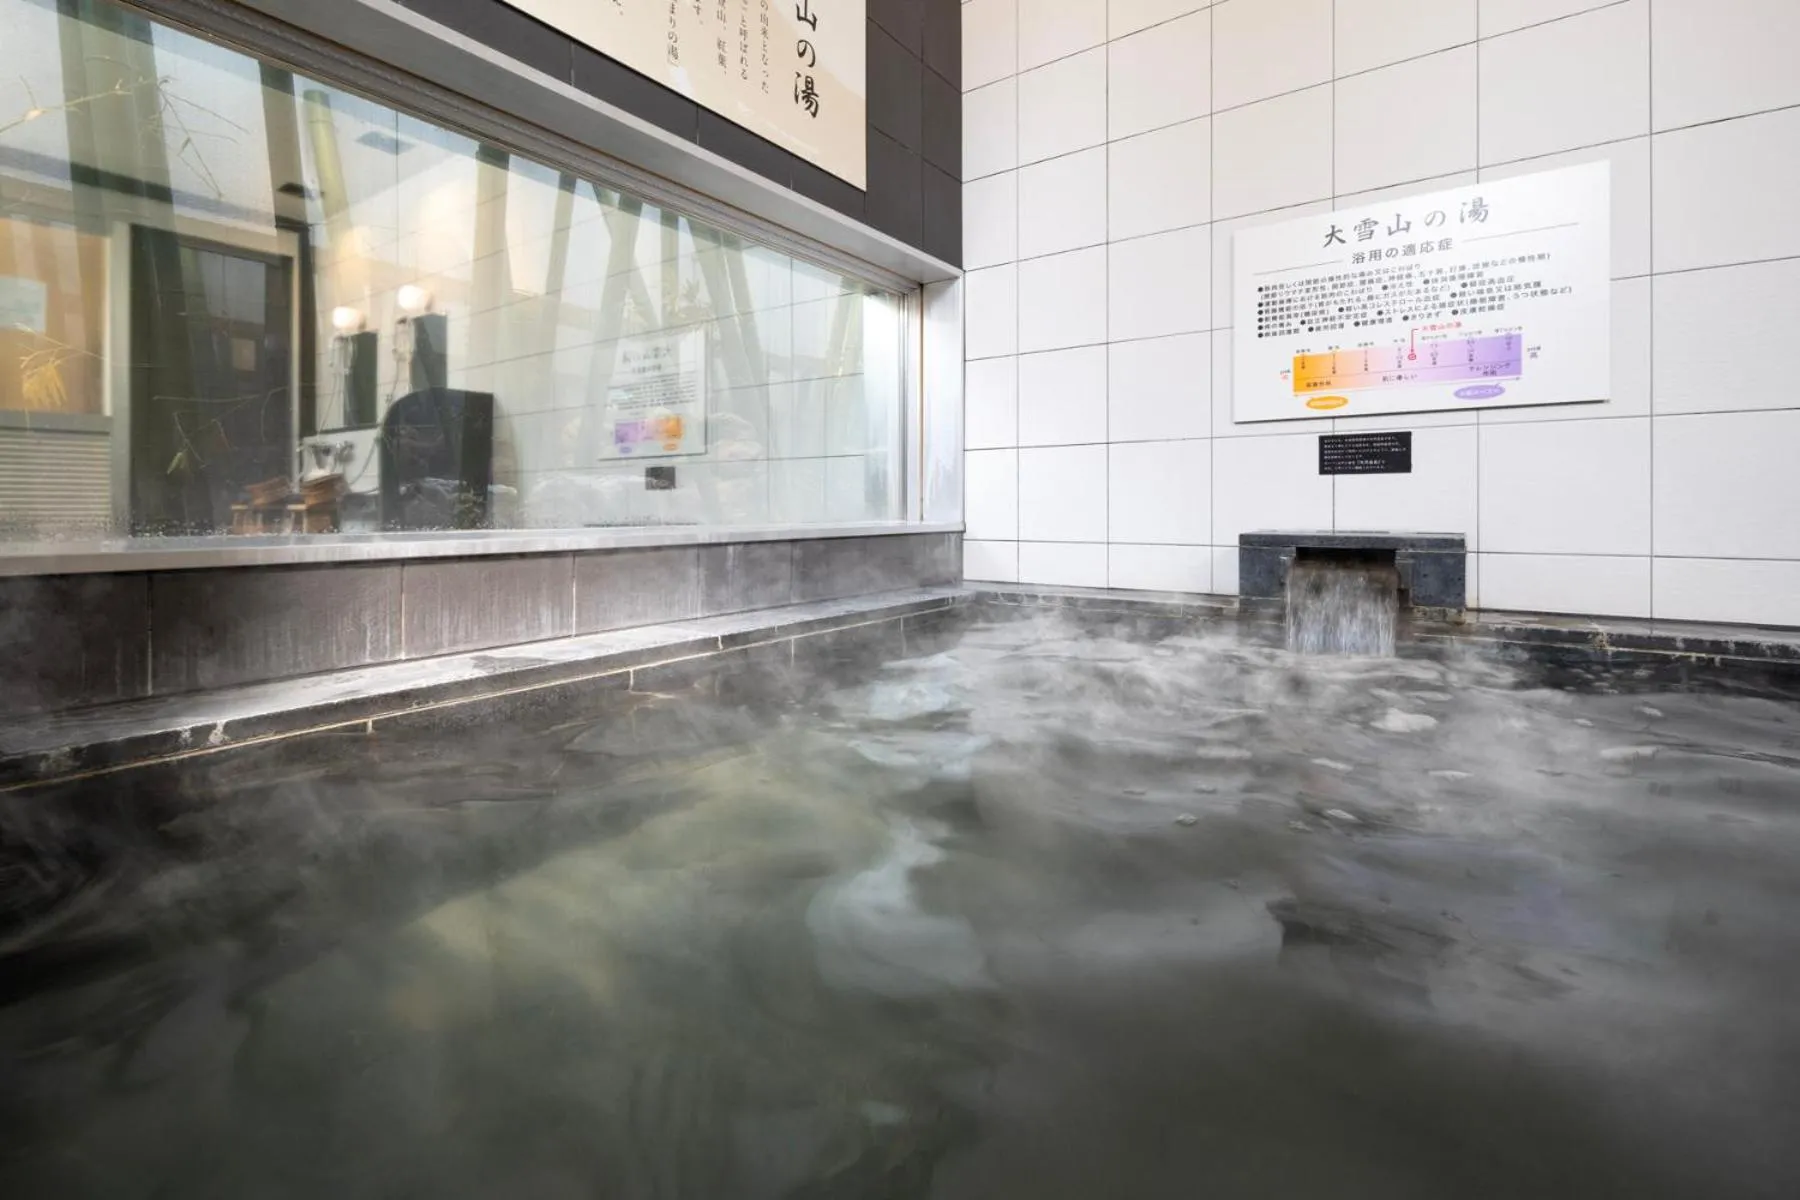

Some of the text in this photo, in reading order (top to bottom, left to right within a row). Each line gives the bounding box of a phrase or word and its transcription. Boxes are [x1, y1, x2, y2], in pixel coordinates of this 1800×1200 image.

[794, 0, 820, 119] 山の湯
[1323, 195, 1490, 248] 大雪山の湯
[1352, 237, 1453, 265] 浴用の適応症
